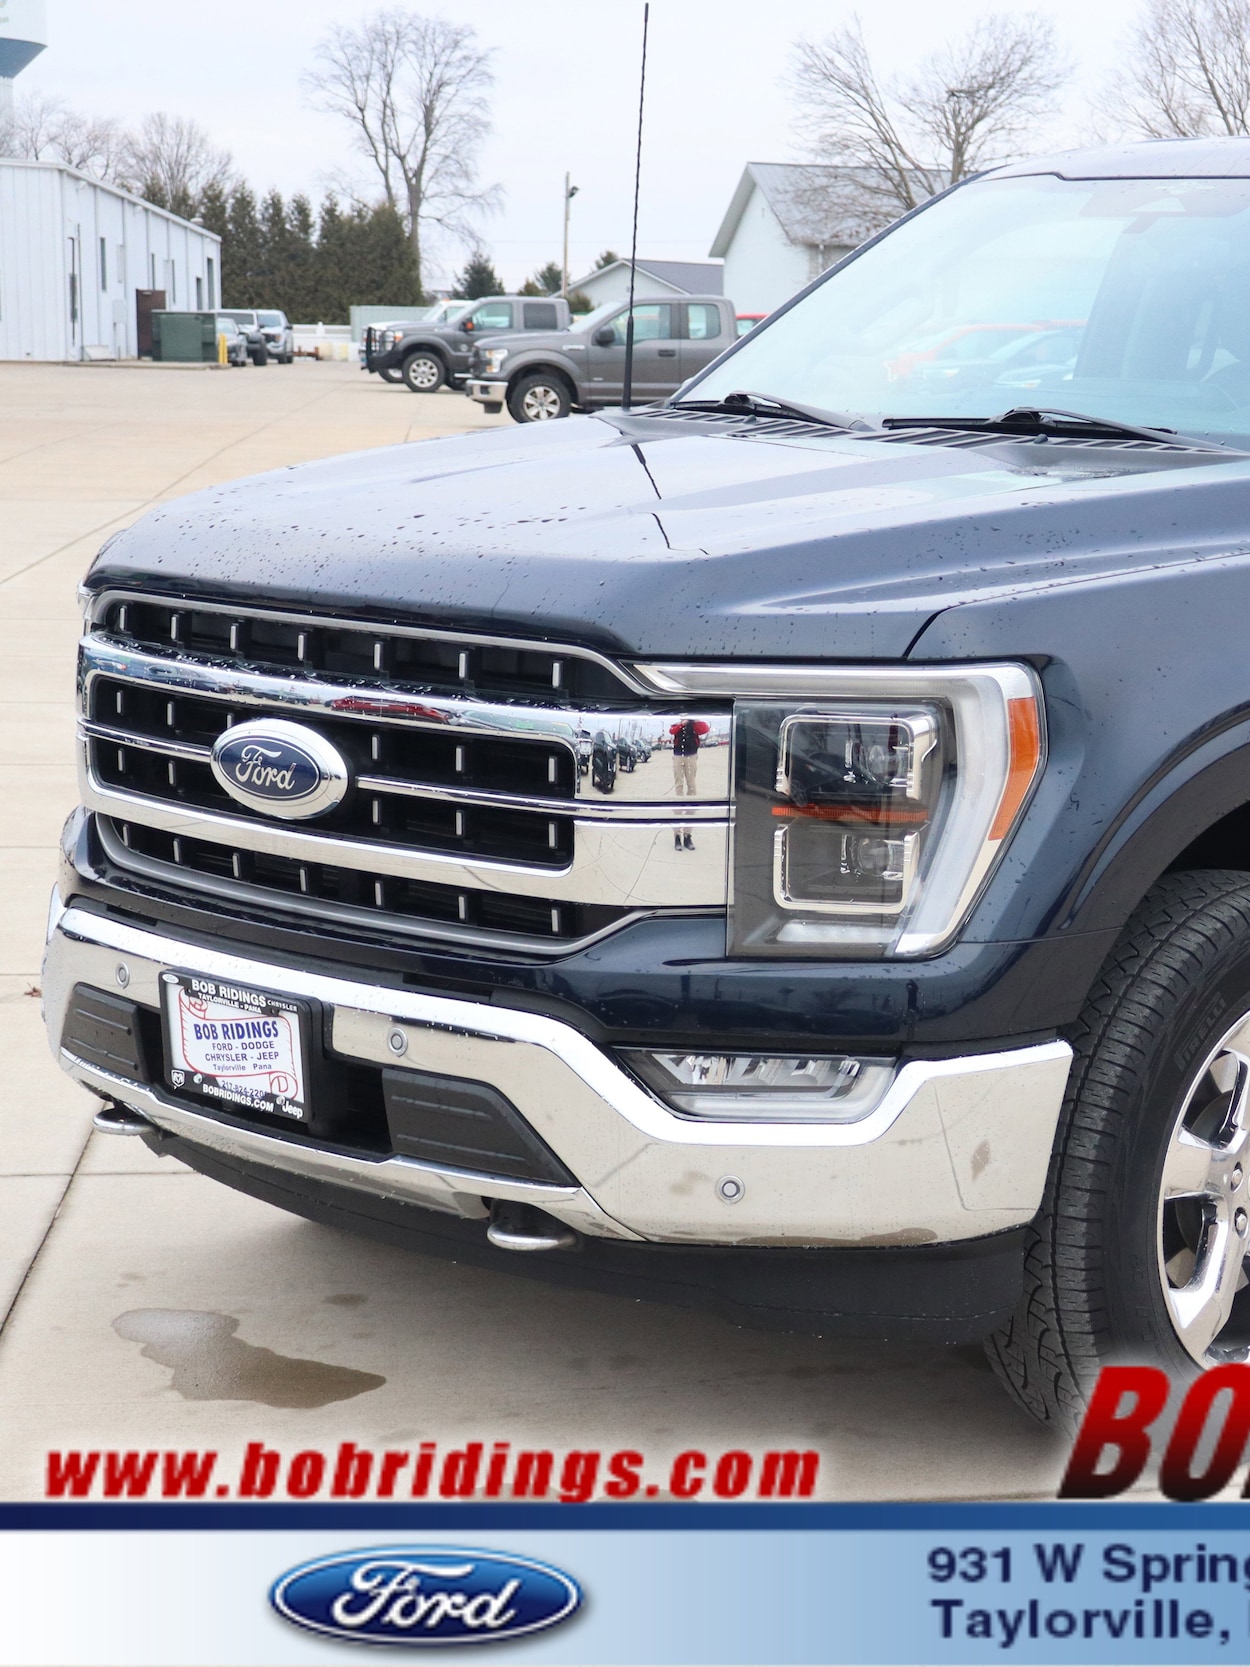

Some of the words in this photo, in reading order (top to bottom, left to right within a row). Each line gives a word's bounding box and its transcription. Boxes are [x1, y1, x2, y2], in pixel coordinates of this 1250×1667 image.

[235, 745, 297, 790] Ford
[191, 979, 217, 995] BOB
[219, 987, 267, 1007] RIDINGS
[198, 993, 240, 1008] TAYLORVILLE
[244, 1003, 262, 1014] PANA
[267, 999, 298, 1012] CHRYSLER
[194, 1023, 218, 1040] BOB
[223, 1020, 279, 1040] RIDINGS
[1174, 991, 1226, 1073] PIRELLI
[212, 1042, 233, 1051] FORD
[241, 1041, 275, 1050] DODGE
[205, 1053, 247, 1062] CHRYSLER
[257, 1052, 279, 1060] JEEP
[213, 1063, 246, 1072] Taylorville
[202, 1084, 275, 1113] BOBRIDINGS.COM
[281, 1099, 303, 1119] Jeep
